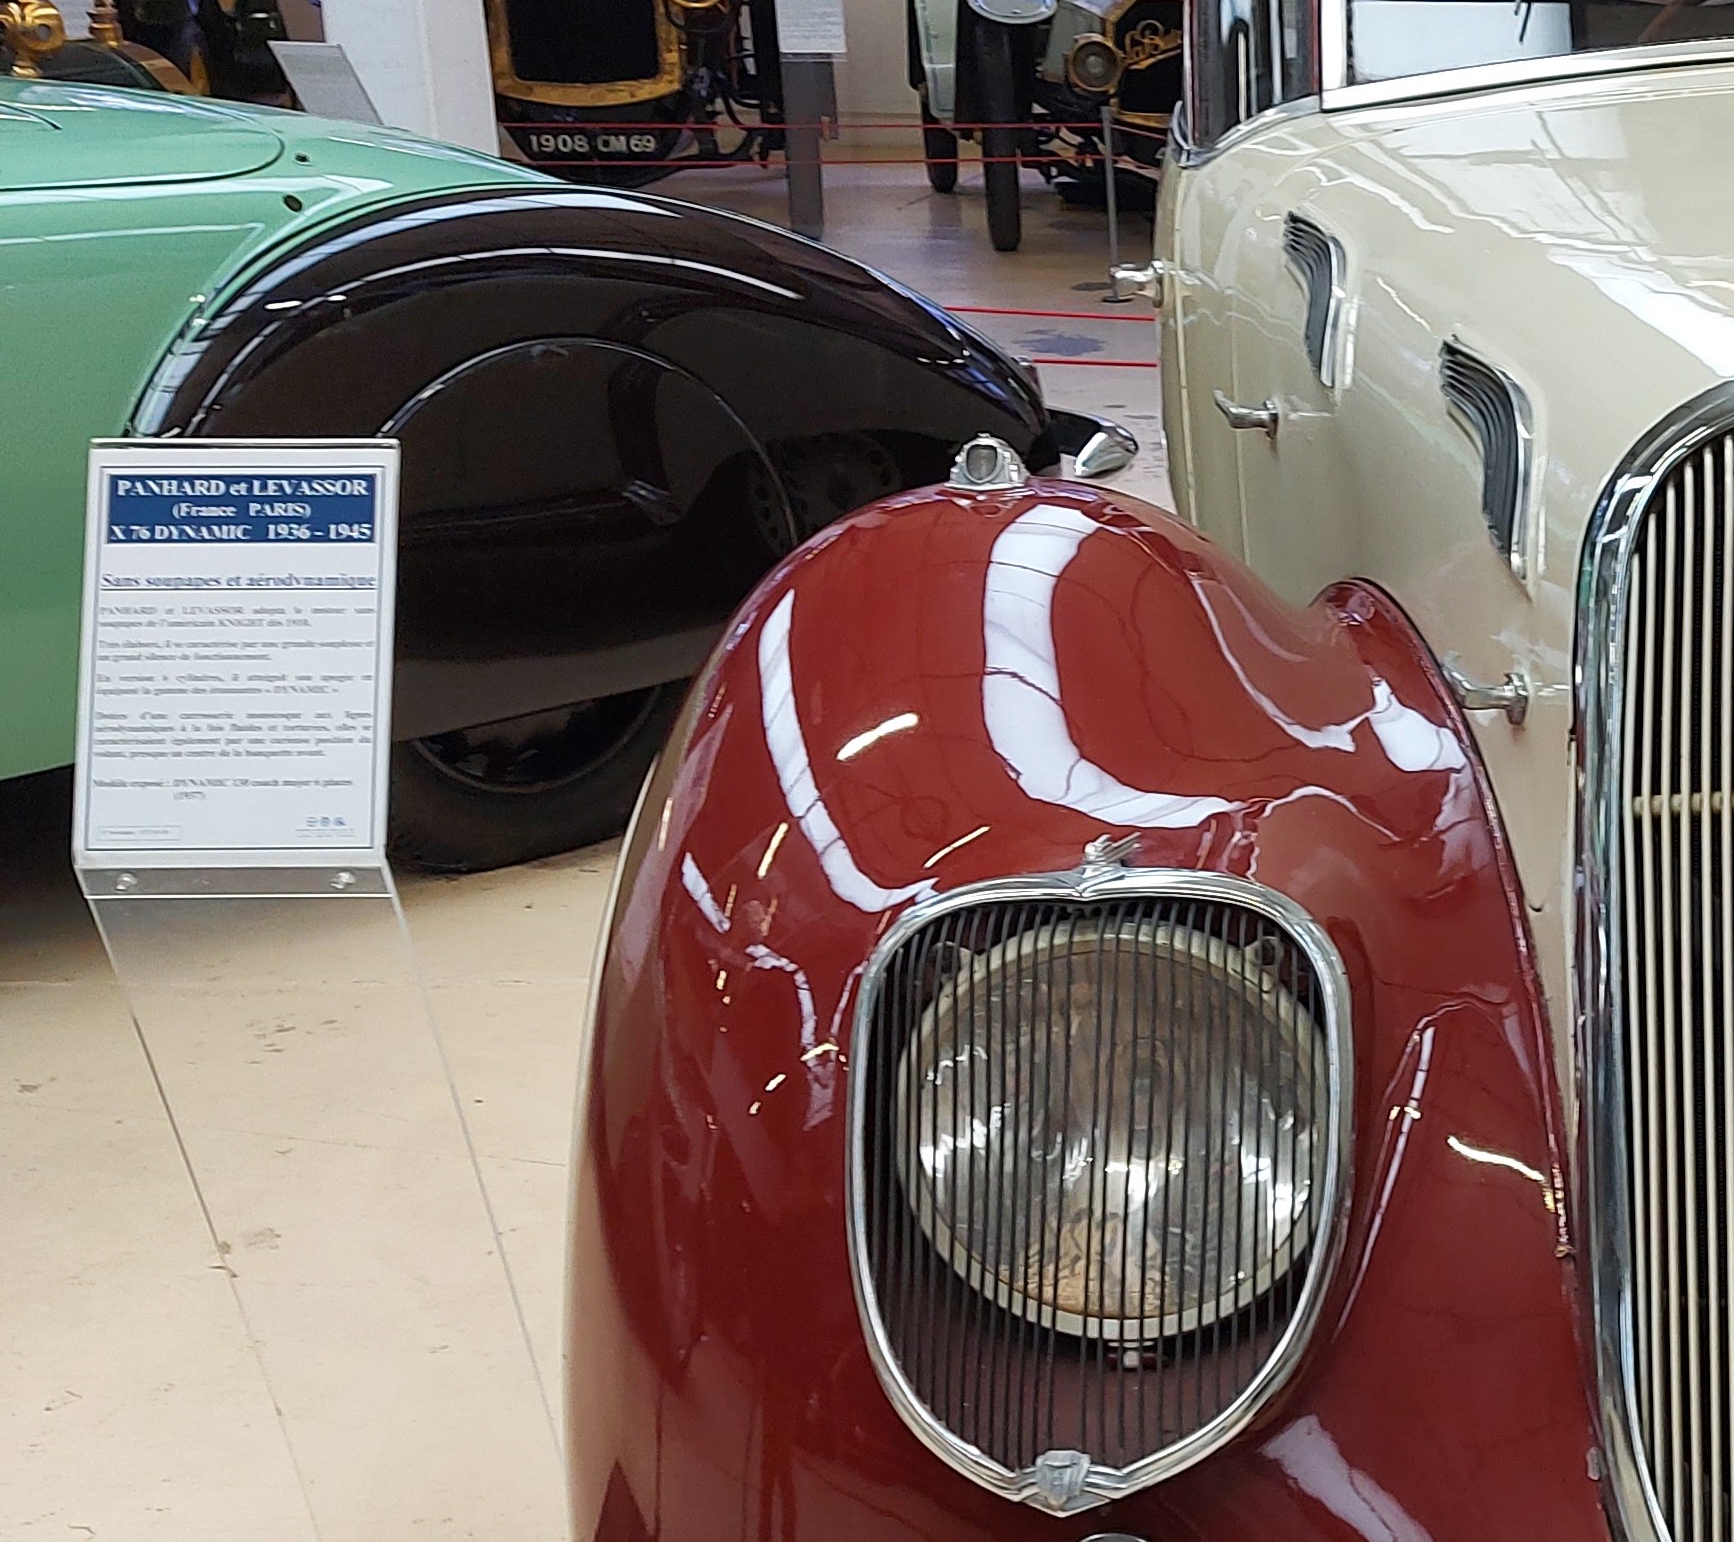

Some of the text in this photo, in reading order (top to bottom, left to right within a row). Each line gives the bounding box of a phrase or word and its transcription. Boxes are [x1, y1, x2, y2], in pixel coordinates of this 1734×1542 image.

[529, 134, 590, 153] 1908
[629, 134, 657, 153] 69
[117, 479, 369, 496] PANHARD et LEVASSOR
[172, 502, 312, 519] (France PARIS)
[110, 525, 128, 540] X
[129, 524, 151, 540] 76
[154, 524, 252, 540] DYNAMIC
[267, 523, 310, 540] 1936
[328, 523, 372, 540] 1945
[101, 573, 140, 587] Sans
